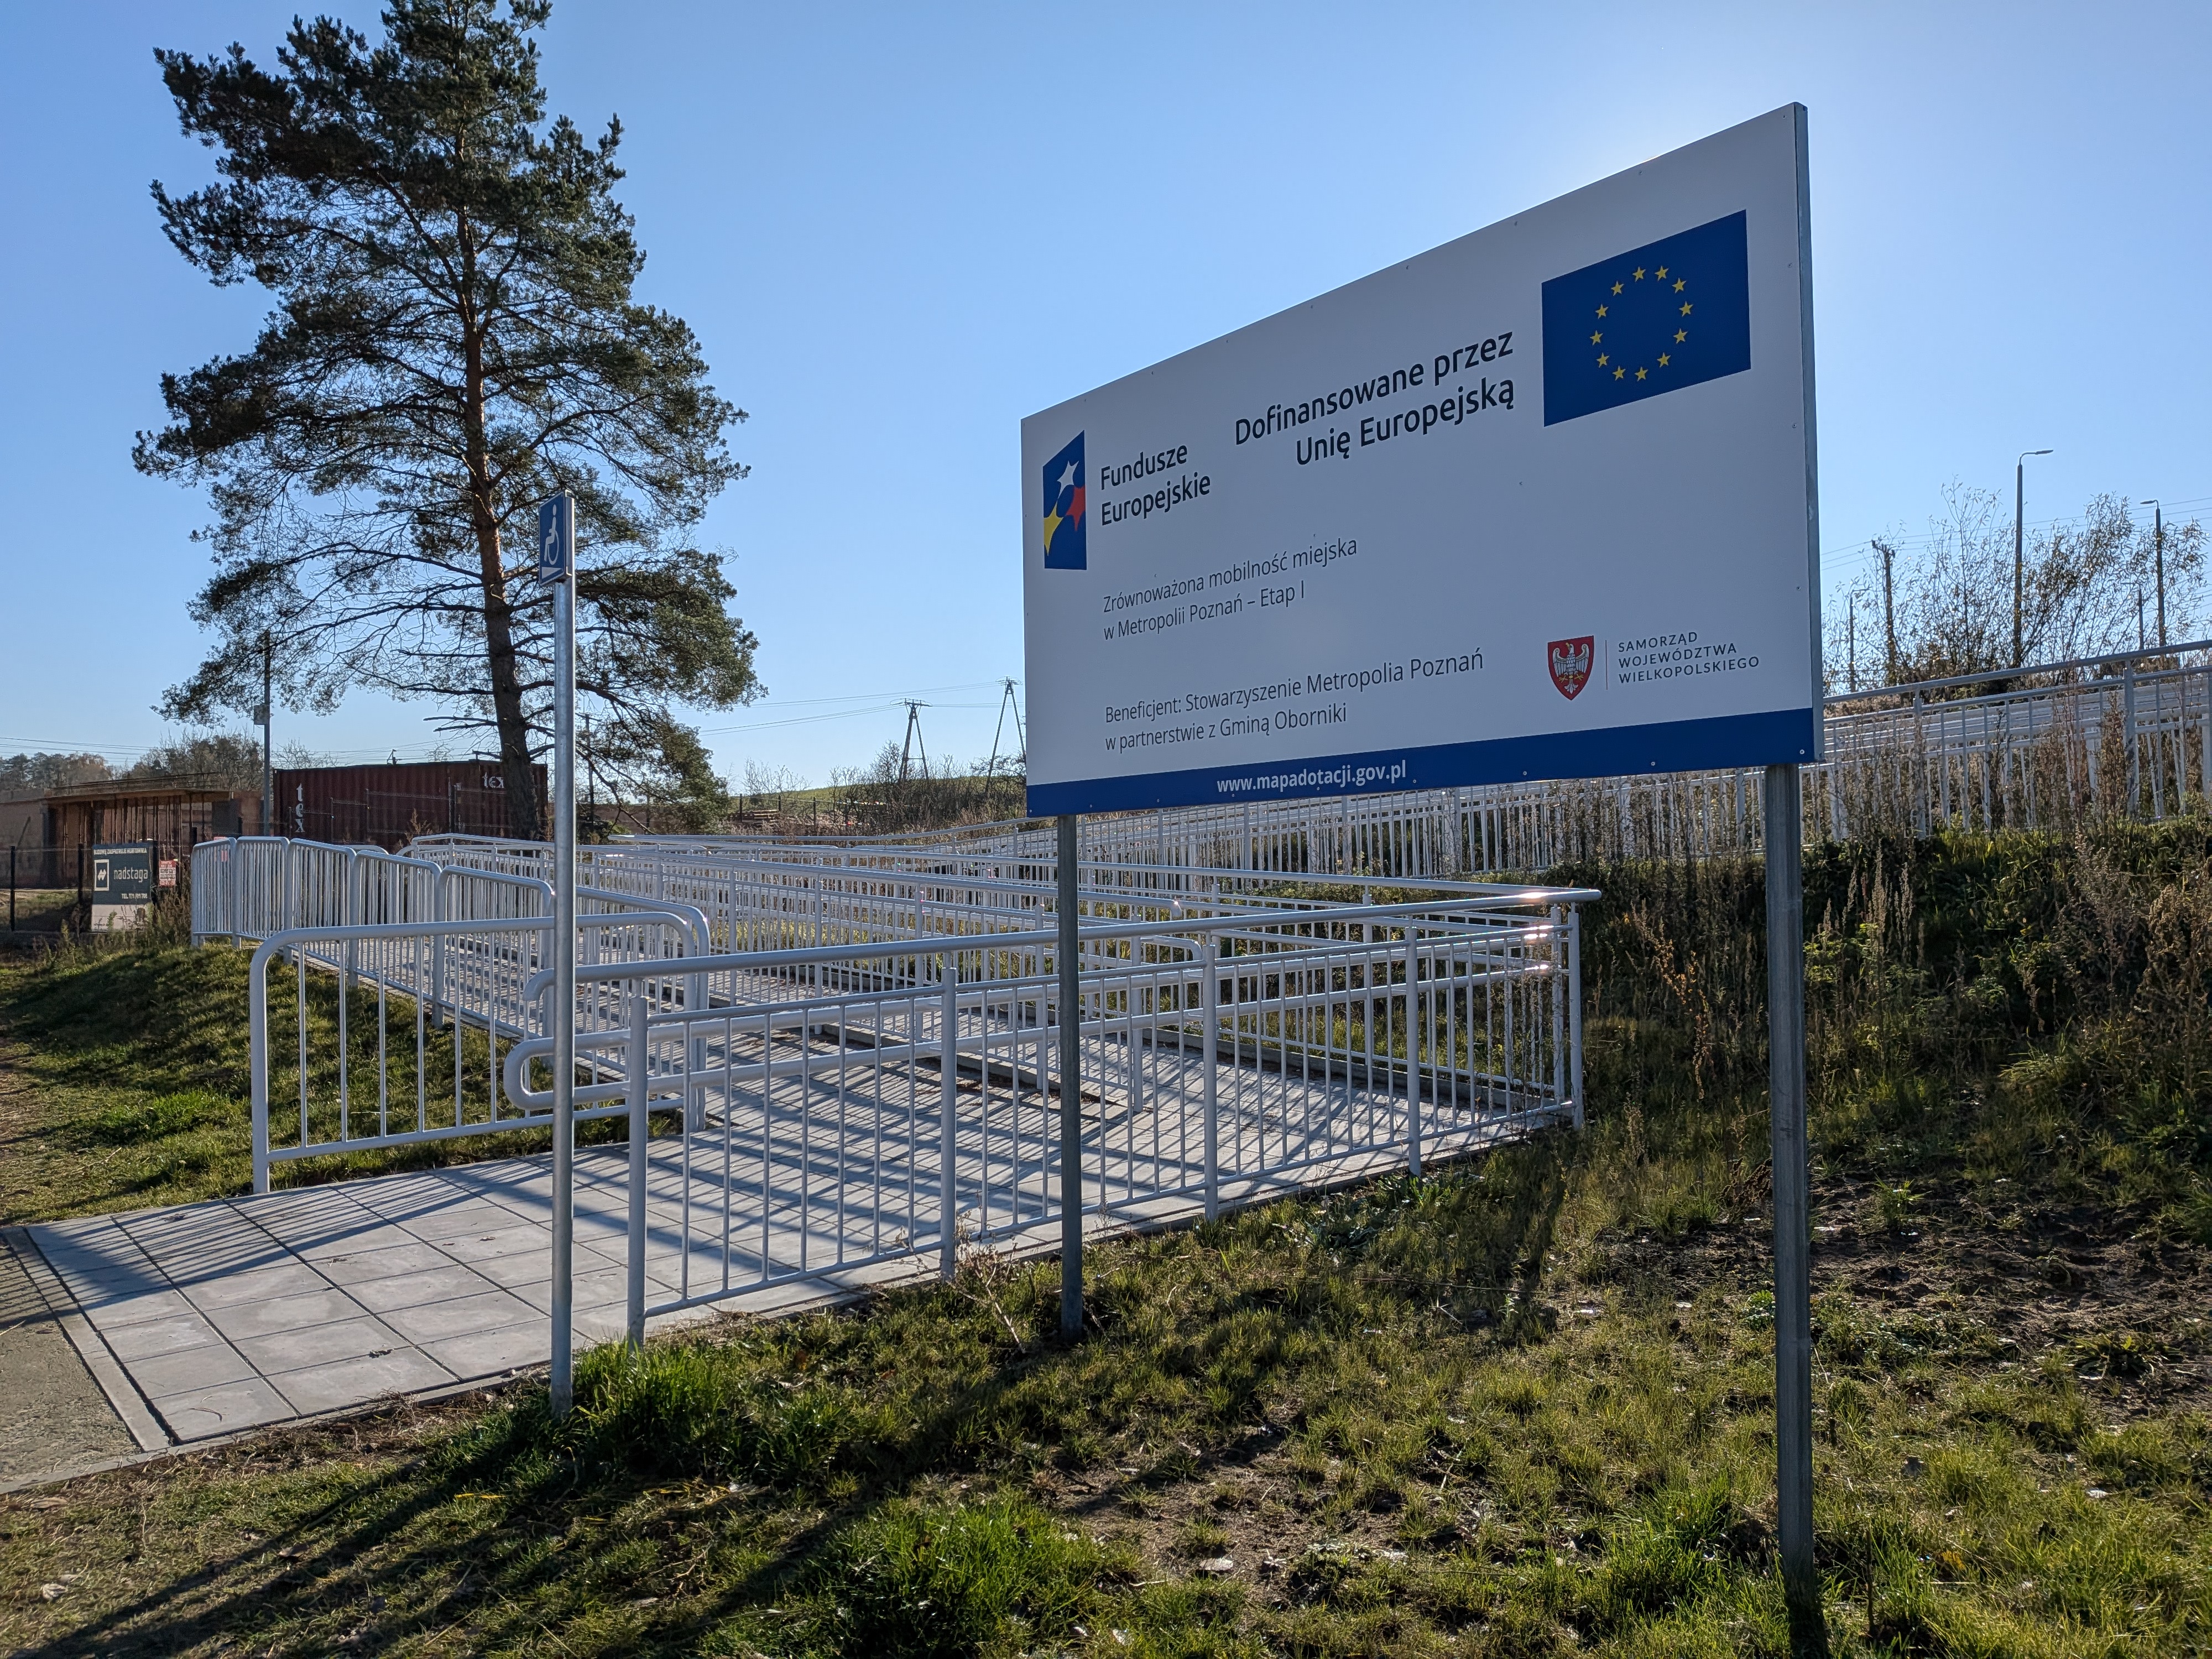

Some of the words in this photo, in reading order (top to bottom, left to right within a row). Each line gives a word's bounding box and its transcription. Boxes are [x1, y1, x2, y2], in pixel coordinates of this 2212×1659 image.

[1235, 363, 1424, 445] Dofinansowane
[1434, 331, 1513, 387] przez
[1296, 429, 1350, 465] Unię
[1360, 377, 1514, 447] Europejską
[1101, 445, 1187, 491] Fundusze
[1102, 472, 1211, 526] Europejskie
[1103, 577, 1204, 613] Zrównoważona
[1209, 551, 1288, 588] mobilność
[1293, 538, 1357, 568] miejska
[1103, 626, 1115, 640] w
[1118, 606, 1185, 638] Metropolii
[1190, 593, 1243, 622] Poznań
[1261, 587, 1295, 608] Etap
[1301, 580, 1304, 599] I
[1618, 632, 1697, 653] SAMORZĄD
[1618, 643, 1737, 669] WOJEWÓDZTWA
[1106, 697, 1181, 723] Beneficjent:
[1186, 681, 1301, 712] Stowarzyszenie
[1307, 662, 1404, 694] Metropolia
[1411, 647, 1483, 679] Poznań
[1619, 656, 1759, 684] WIELKOPOLSKIEGO
[1105, 737, 1117, 750] w
[1120, 722, 1204, 754] partnerstwie
[1208, 724, 1216, 738] z
[1220, 715, 1270, 737] Gminą
[1275, 702, 1346, 729] Oborniki
[1217, 759, 1406, 792] www.mapadotacji.gov.pl
[114, 867, 148, 883] nadstaga
